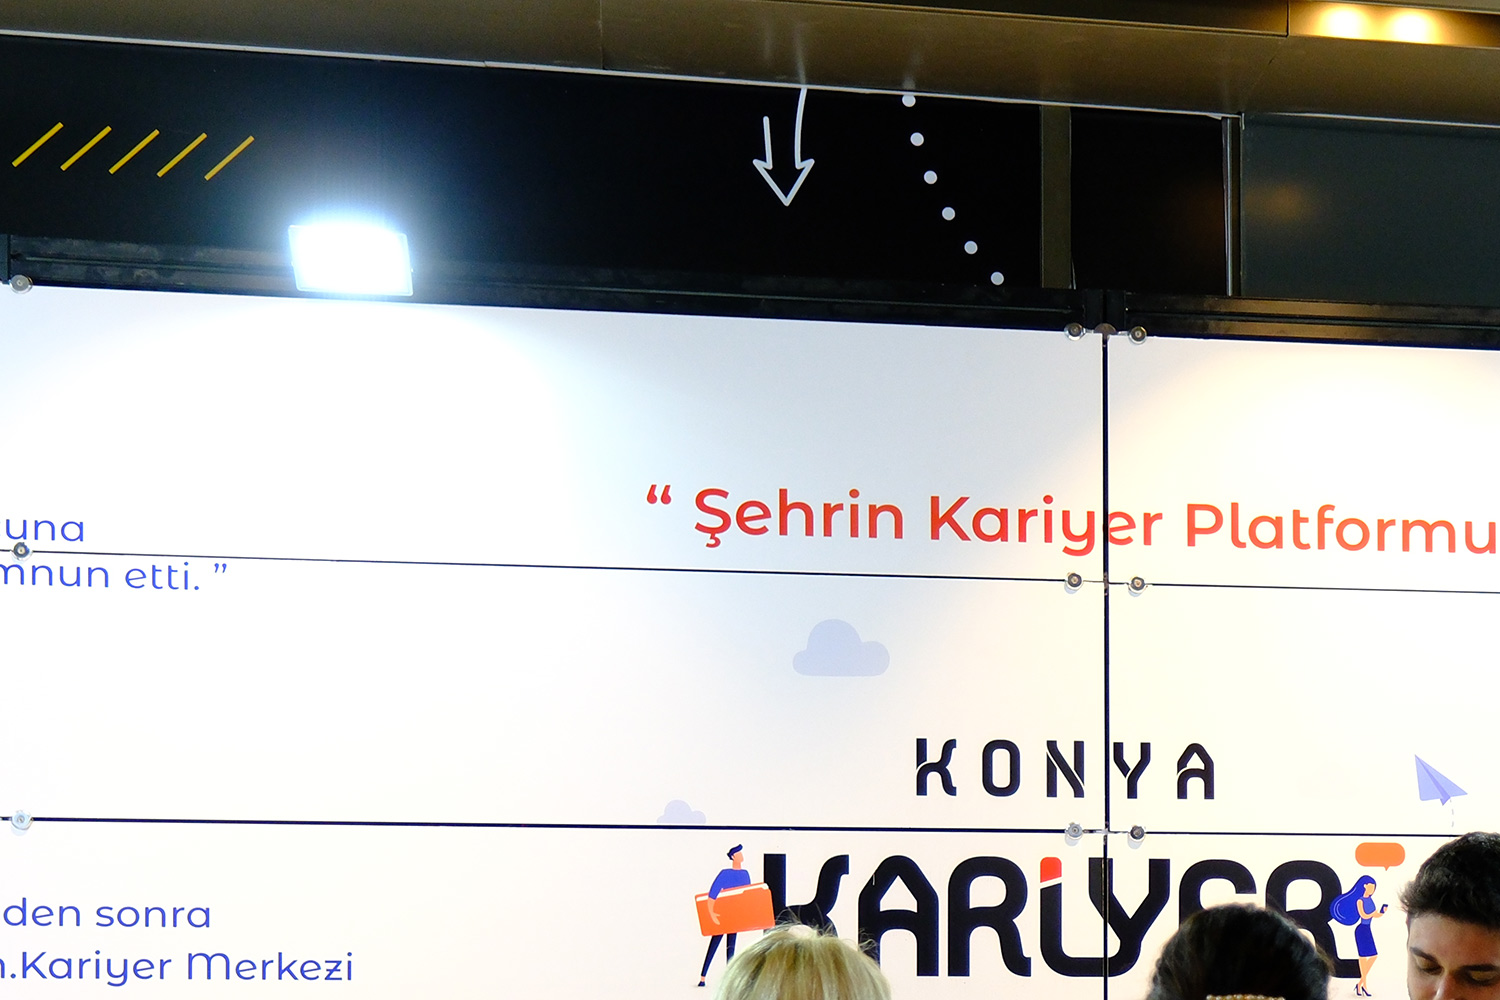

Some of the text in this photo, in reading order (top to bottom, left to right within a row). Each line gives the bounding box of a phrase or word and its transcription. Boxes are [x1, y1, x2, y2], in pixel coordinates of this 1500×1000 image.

[694, 487, 904, 548] Şehrin
[929, 493, 1164, 557] Kariyer
[1185, 500, 1498, 555] Platformu
[124, 561, 200, 591] etti.
[915, 737, 1216, 800] KONYA
[3, 897, 210, 929] den sonra
[187, 951, 353, 981] Merkezi
